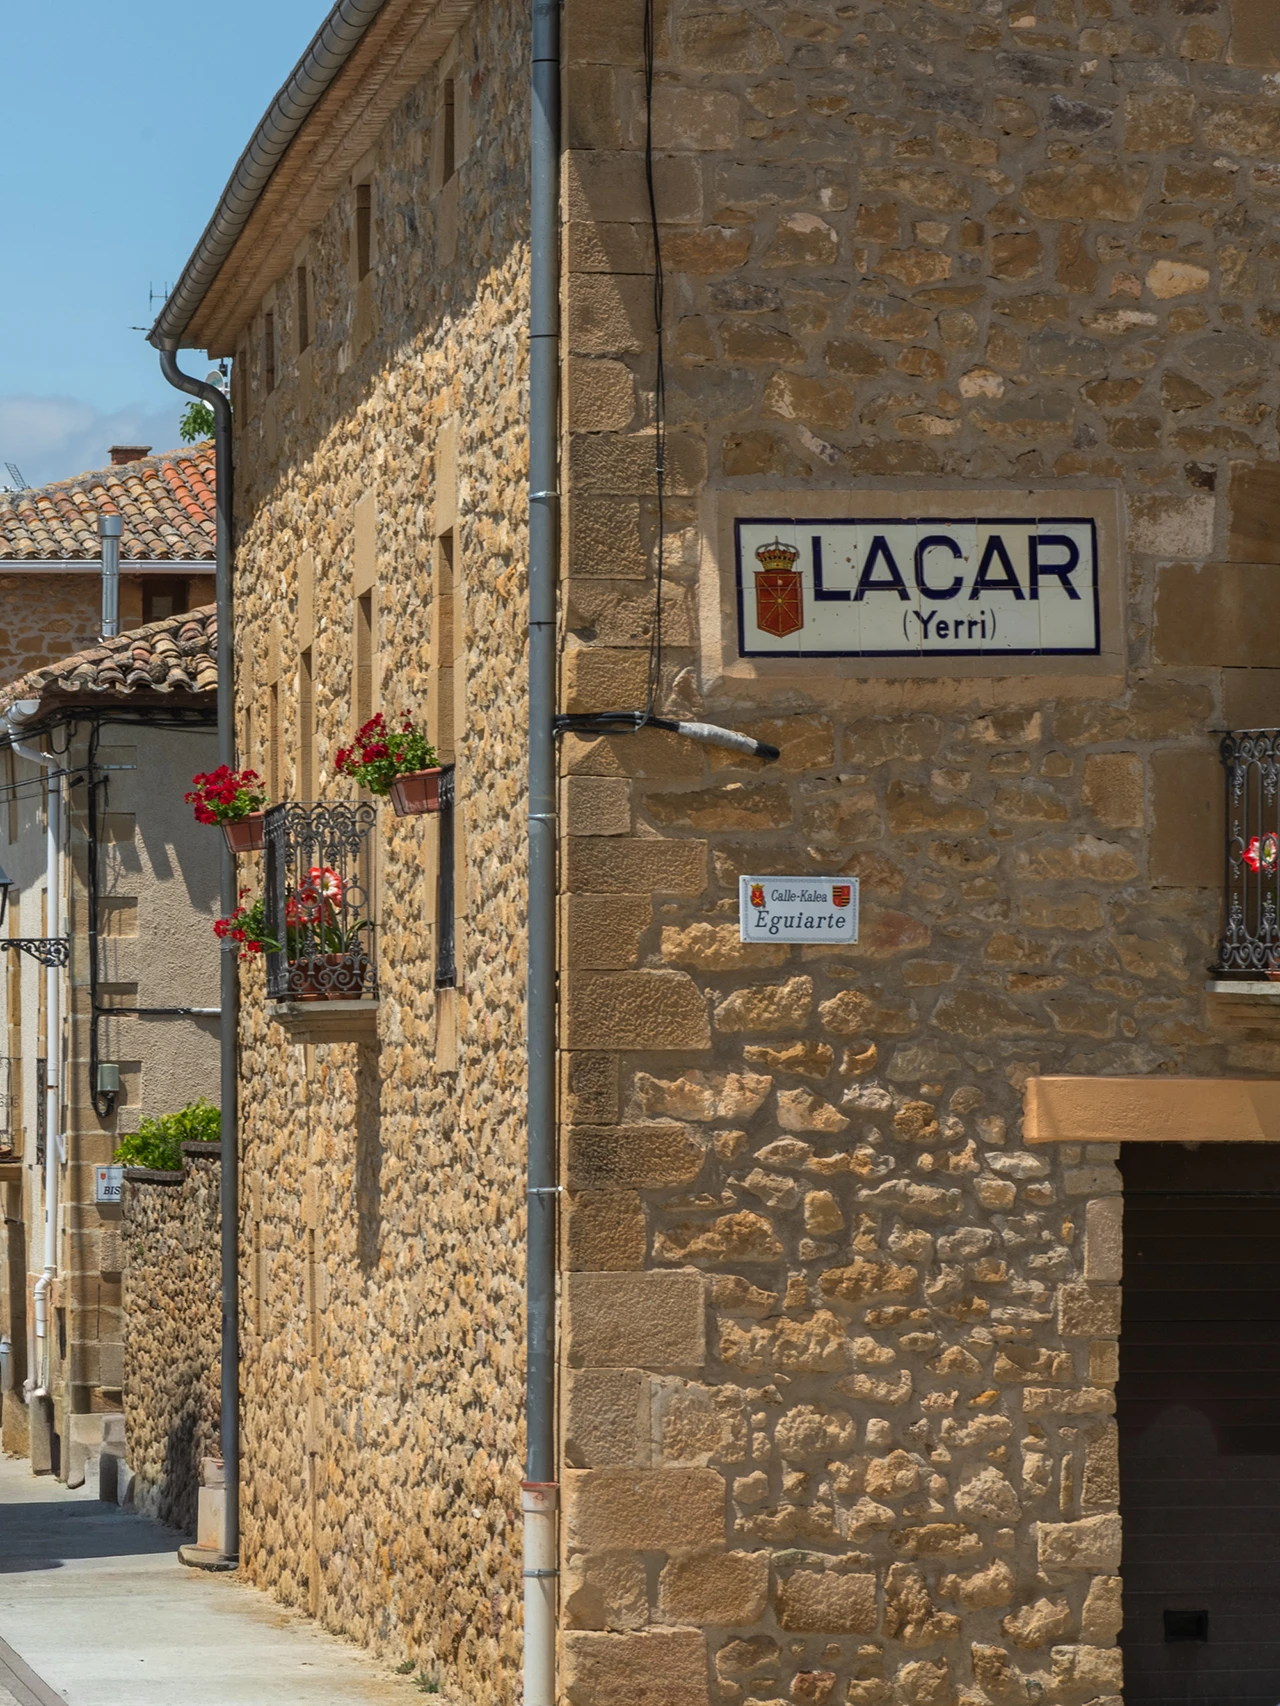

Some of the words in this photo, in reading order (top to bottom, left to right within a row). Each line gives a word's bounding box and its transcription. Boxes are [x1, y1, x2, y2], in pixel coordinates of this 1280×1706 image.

[811, 534, 1082, 602] LACAR
[902, 608, 996, 641] (Yerri)
[754, 910, 846, 935] Eguiarte
